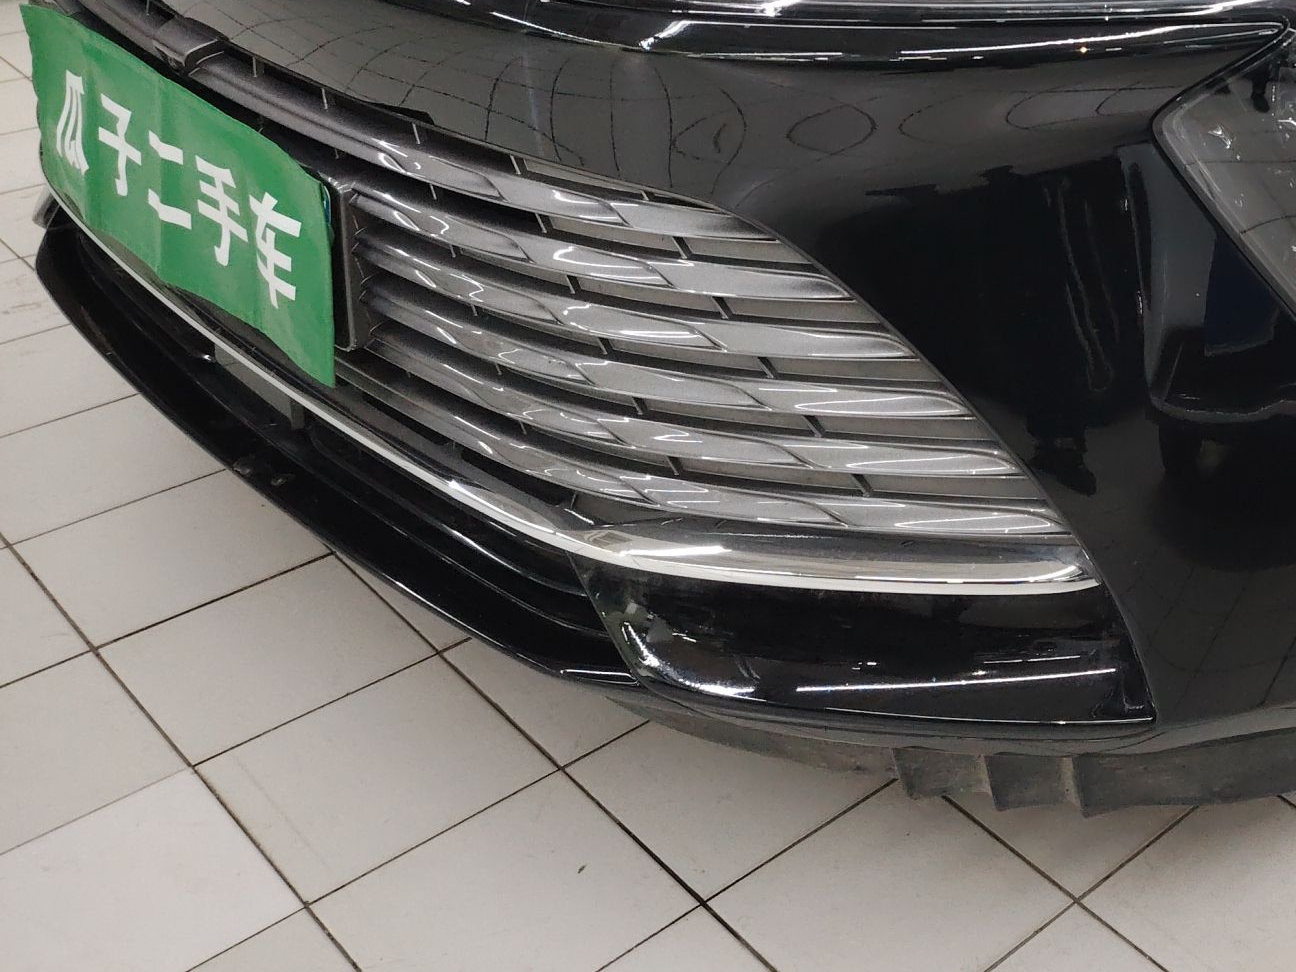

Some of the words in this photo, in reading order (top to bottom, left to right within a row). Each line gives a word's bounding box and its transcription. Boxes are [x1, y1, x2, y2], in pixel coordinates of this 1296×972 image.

[56, 70, 302, 308] 瓜子二手车
